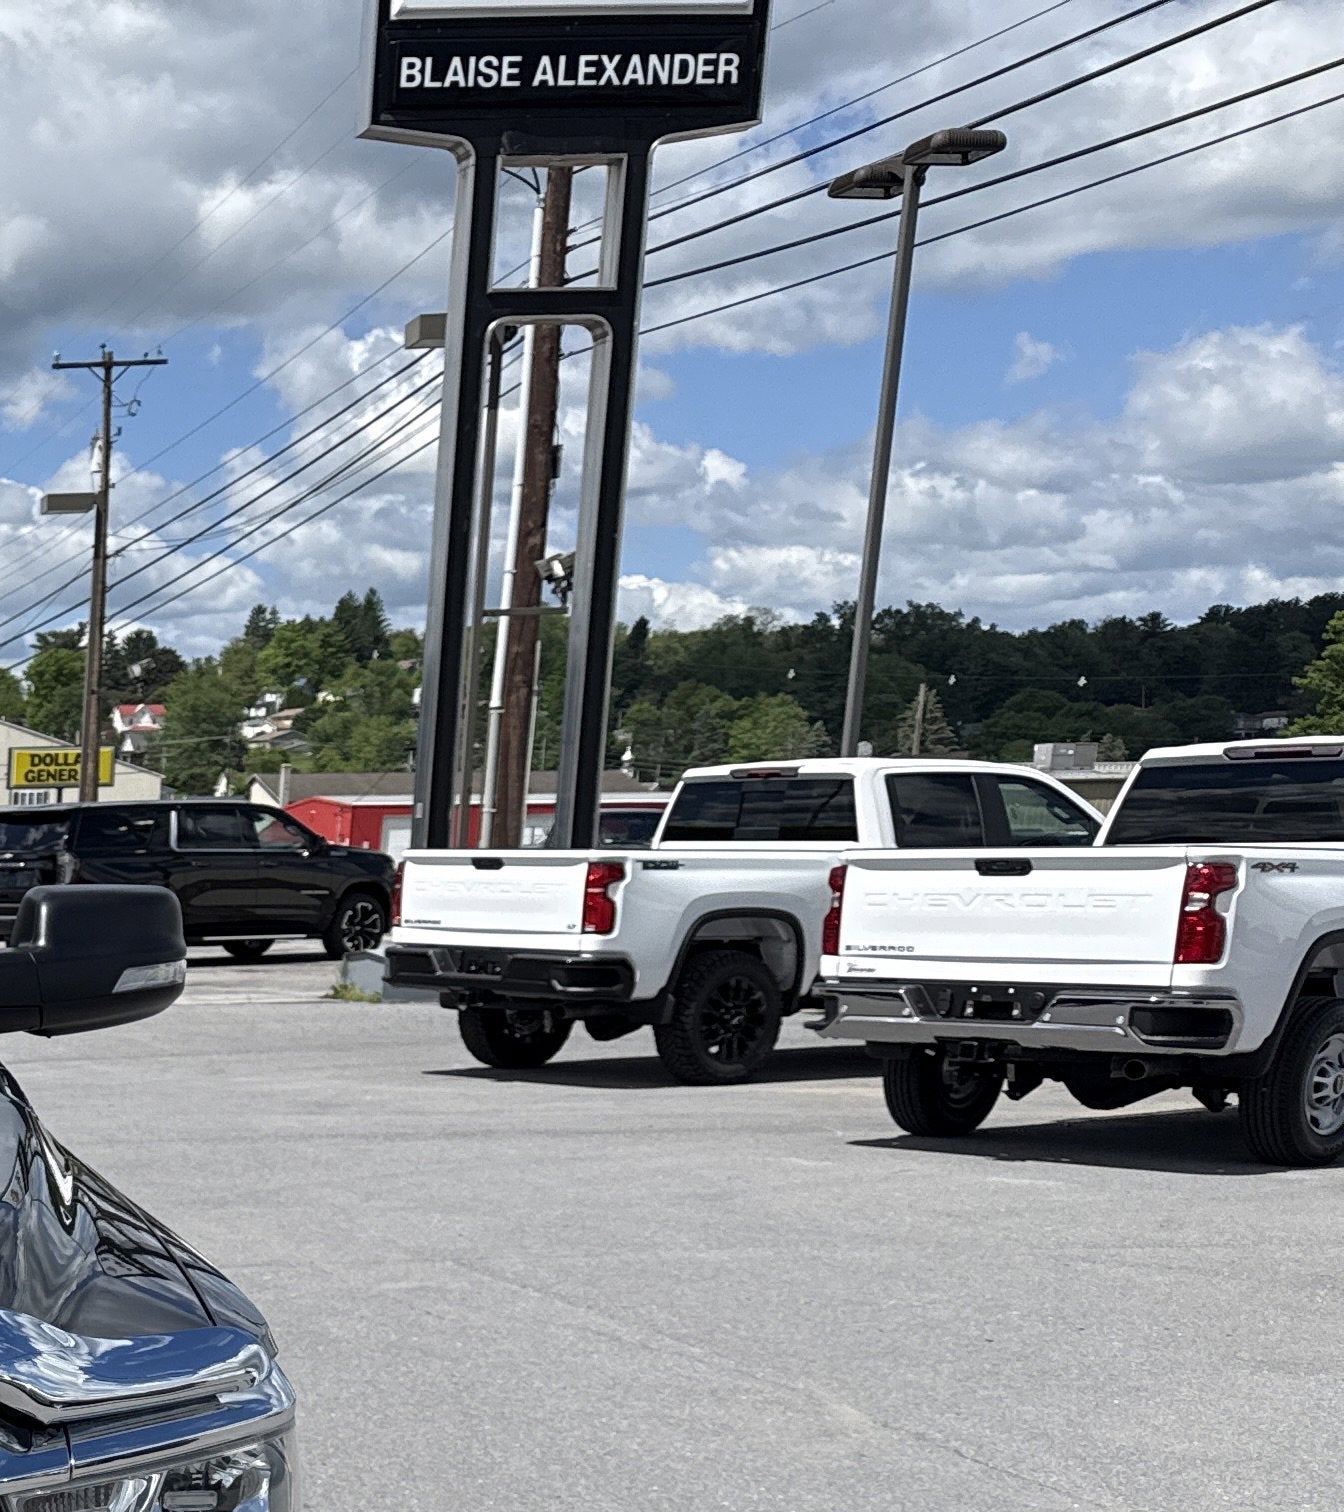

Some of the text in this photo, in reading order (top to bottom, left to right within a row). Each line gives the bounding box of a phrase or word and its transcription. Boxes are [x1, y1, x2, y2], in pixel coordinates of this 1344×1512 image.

[399, 53, 740, 88] BLAISE ALEXANDER
[30, 752, 83, 767] DOLLA
[24, 768, 84, 783] GENER
[863, 892, 1154, 912] CHEVROLET
